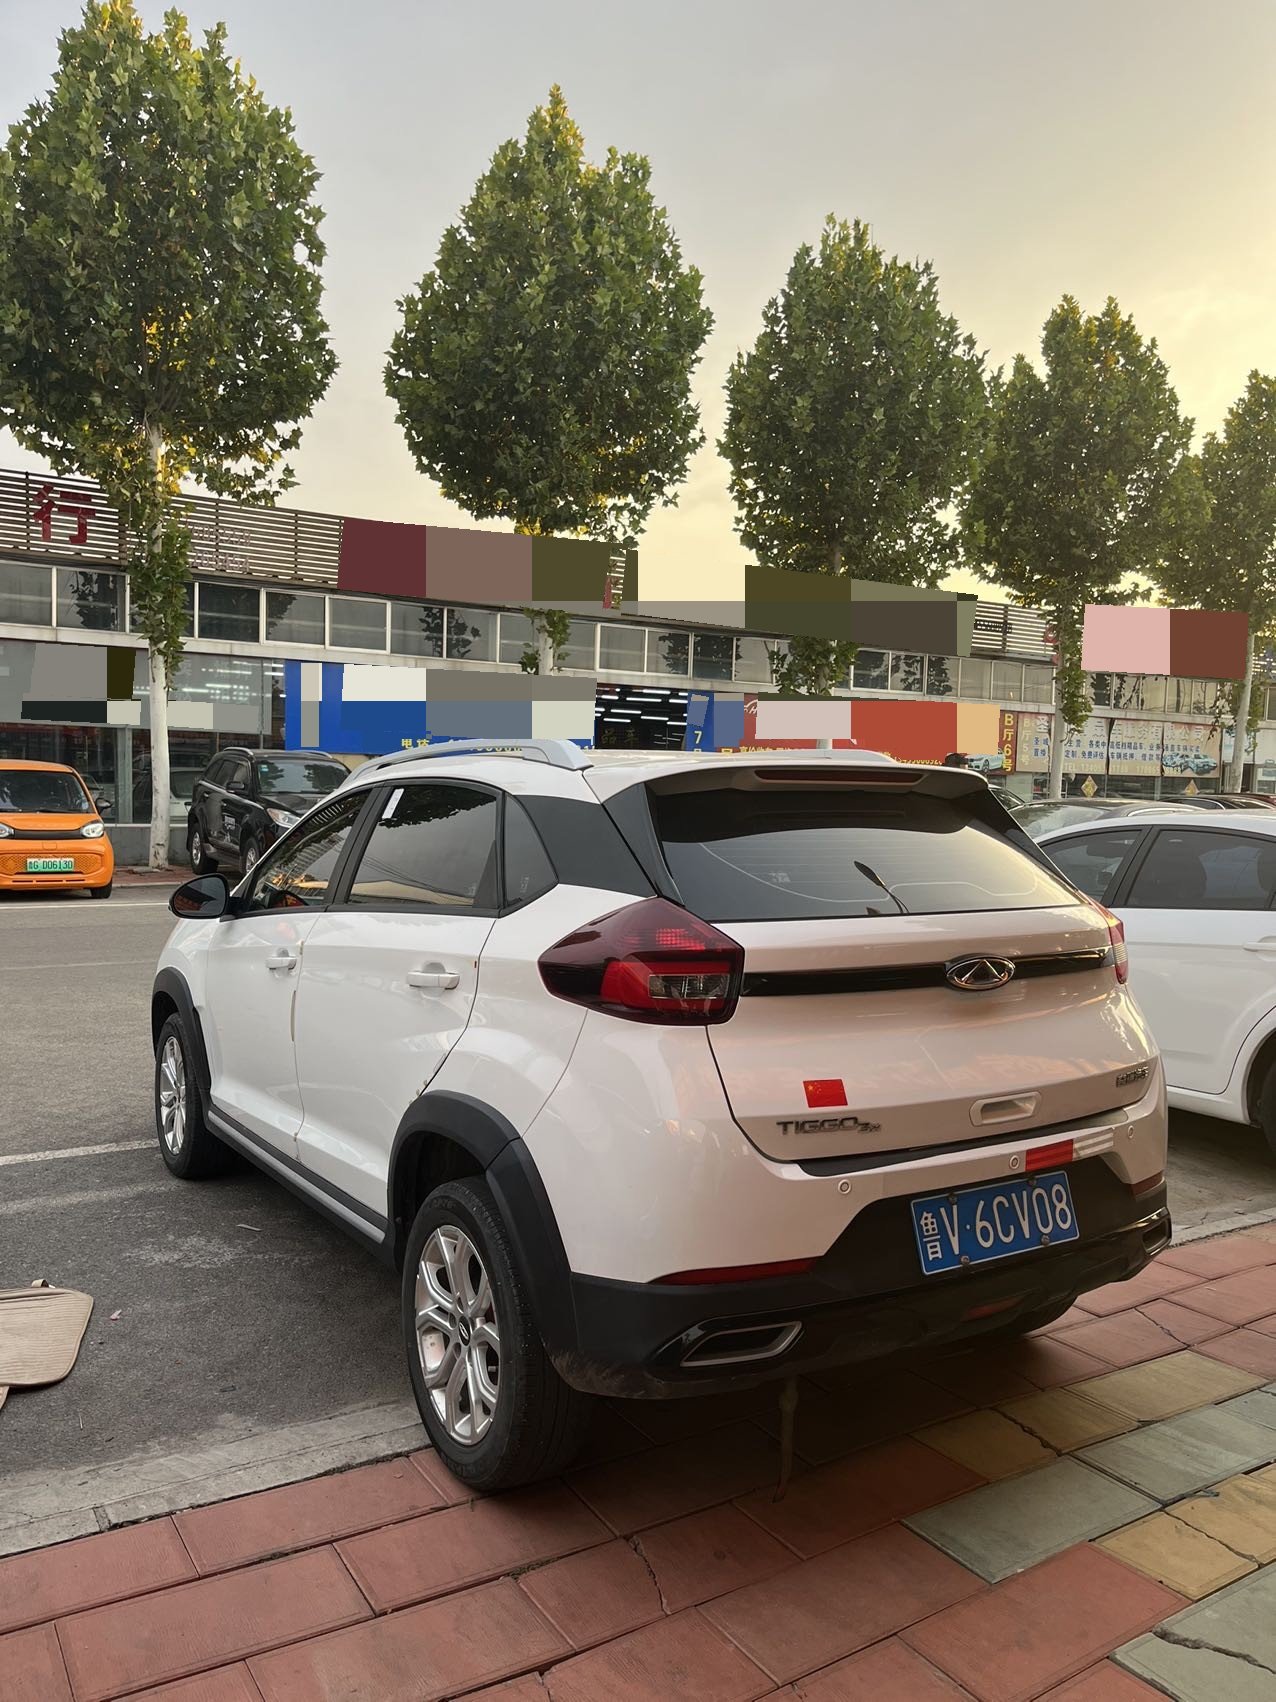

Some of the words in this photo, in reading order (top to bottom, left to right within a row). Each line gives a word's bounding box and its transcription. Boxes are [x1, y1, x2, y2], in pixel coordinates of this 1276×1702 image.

[32, 483, 96, 544] 行
[1002, 712, 1015, 772] B厅6号
[776, 1116, 858, 1135] TIGGO
